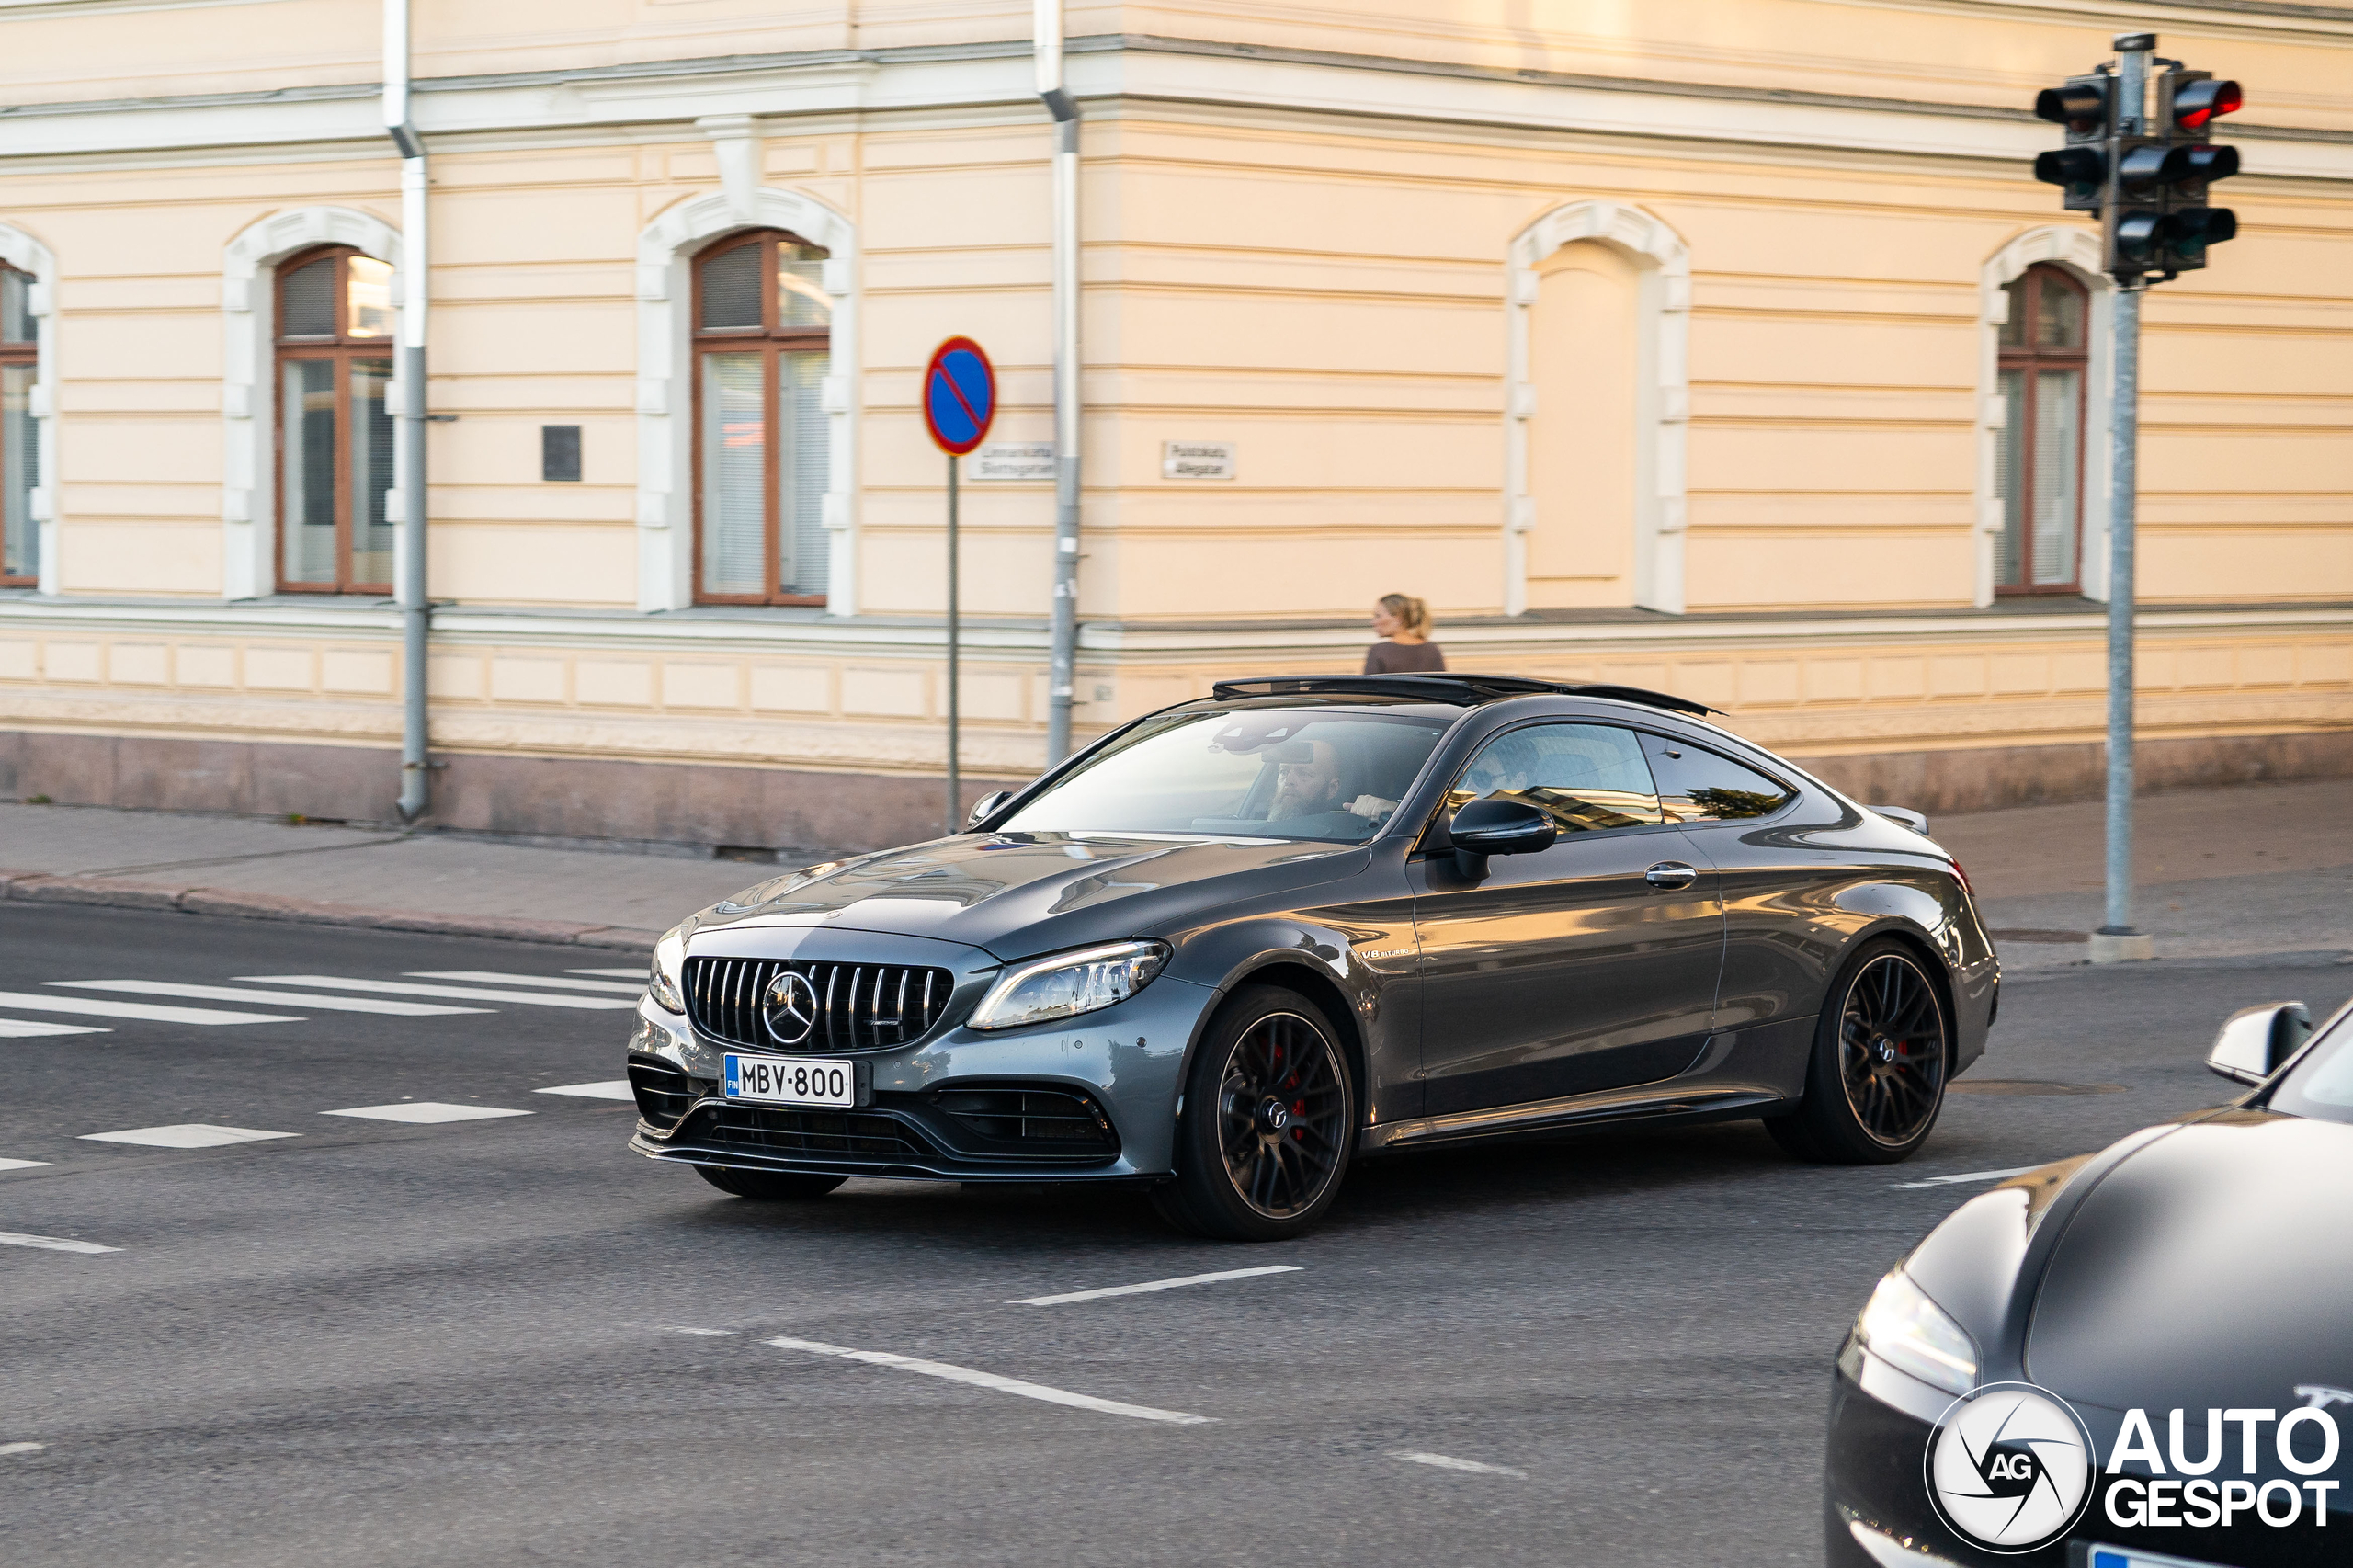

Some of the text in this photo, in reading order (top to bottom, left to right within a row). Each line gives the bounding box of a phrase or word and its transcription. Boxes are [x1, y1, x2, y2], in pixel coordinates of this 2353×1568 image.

[1361, 949, 1409, 959] V8 BITURBO
[727, 1079, 739, 1090] FIN
[741, 1062, 844, 1098] MBV-800
